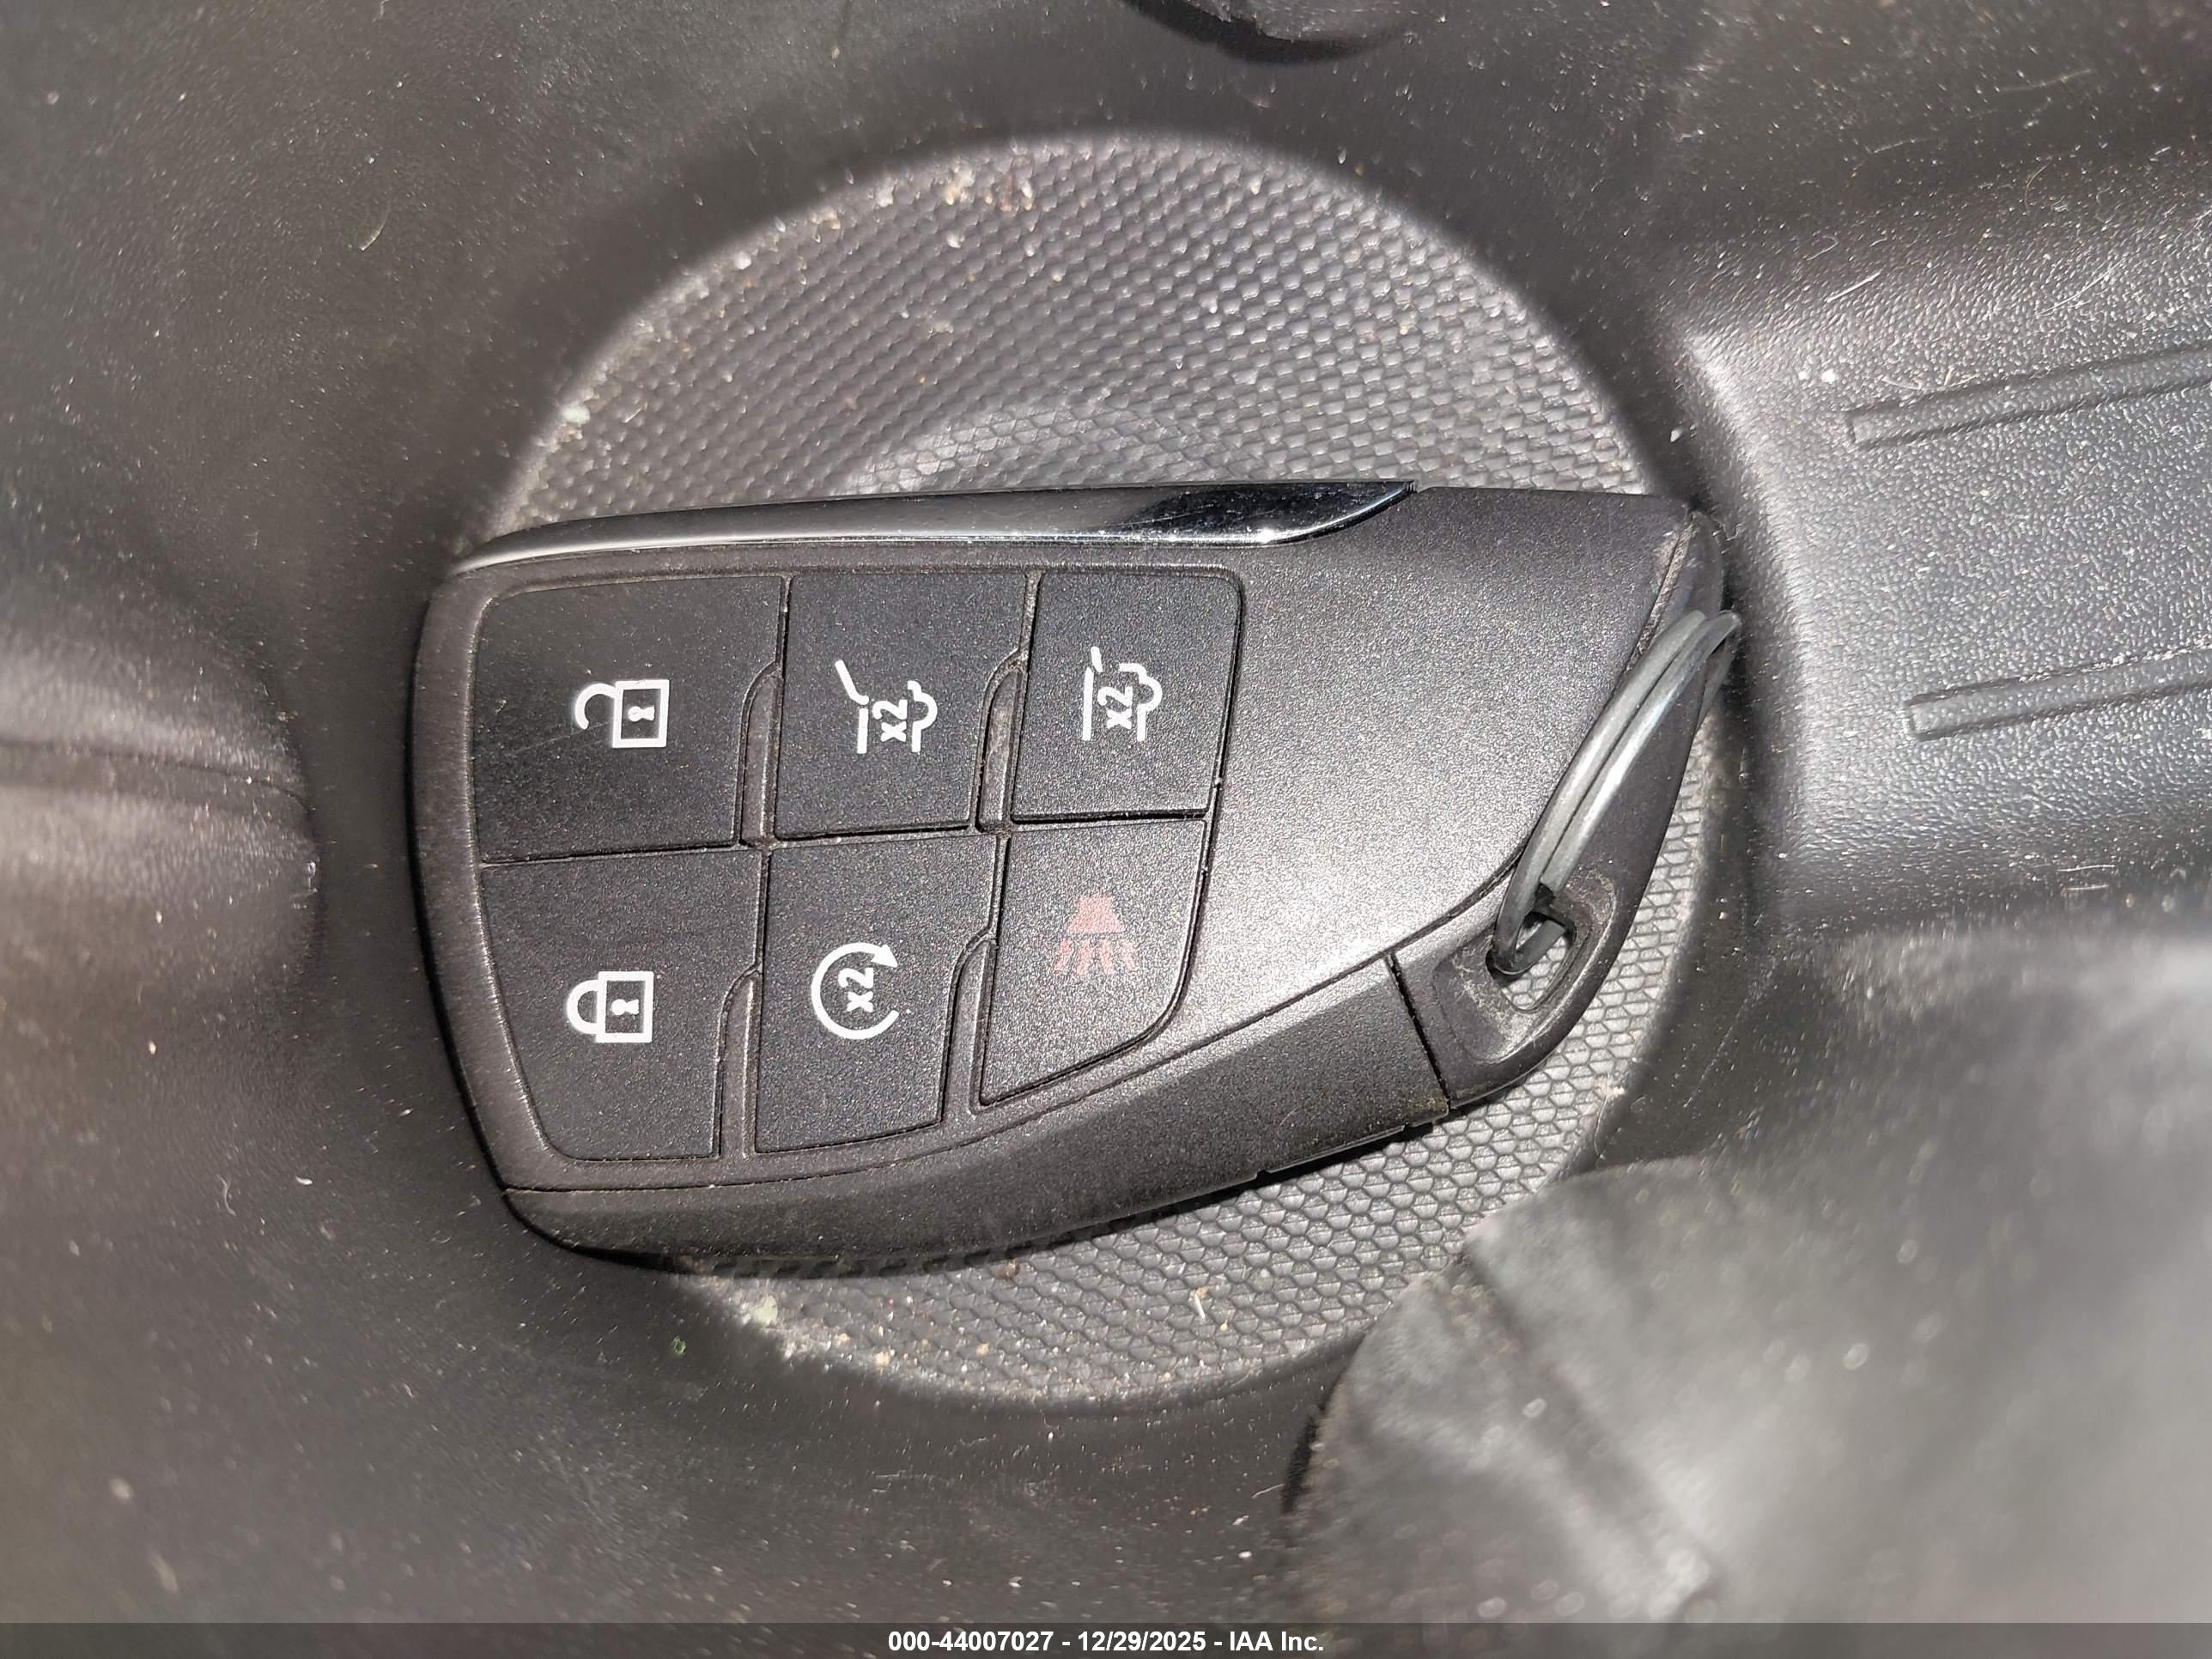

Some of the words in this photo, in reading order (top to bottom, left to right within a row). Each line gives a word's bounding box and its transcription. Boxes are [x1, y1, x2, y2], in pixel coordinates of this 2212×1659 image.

[872, 699, 908, 743] x2
[1097, 685, 1134, 730] x2
[837, 967, 874, 1012] x2
